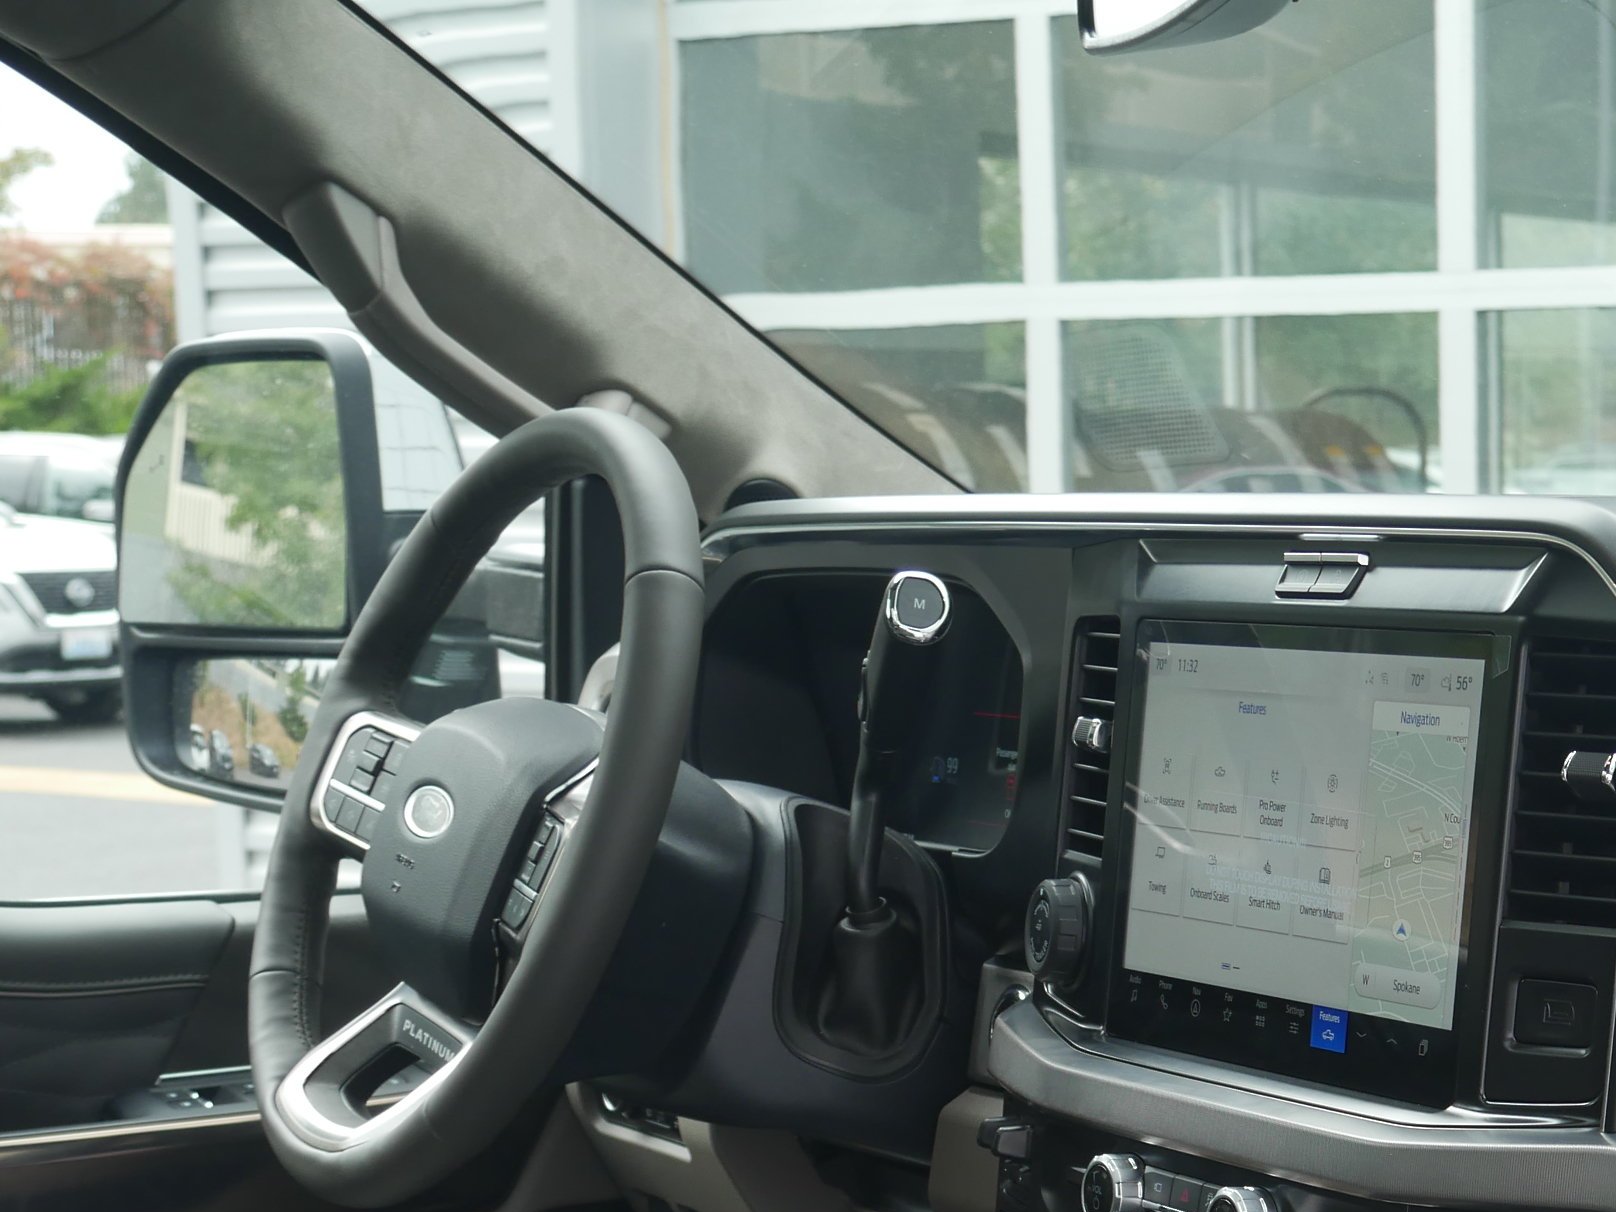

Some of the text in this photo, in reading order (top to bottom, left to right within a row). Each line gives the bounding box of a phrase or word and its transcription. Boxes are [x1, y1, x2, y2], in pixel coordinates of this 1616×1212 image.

[913, 598, 926, 609] M
[1178, 659, 1199, 673] 11:32
[1411, 673, 1425, 687] 70°
[1456, 675, 1473, 691] 56°
[1238, 701, 1267, 716] Features
[1400, 711, 1441, 728] Navigation
[946, 757, 959, 774] 99
[1197, 799, 1238, 815] Running Boards
[1259, 800, 1287, 813] Pro Power
[1259, 815, 1284, 828] Onboard
[1310, 813, 1350, 830] Zone Lighting
[1148, 880, 1167, 895] Towing
[1189, 887, 1230, 904] Onboard Scales
[1248, 896, 1281, 911] Smart Hitch
[1299, 904, 1345, 921] Owner's Manual
[1362, 973, 1421, 996] W Spokane
[1285, 1003, 1306, 1018] Settings
[1319, 1010, 1341, 1025] Features
[402, 1019, 455, 1062] PLATINUM
